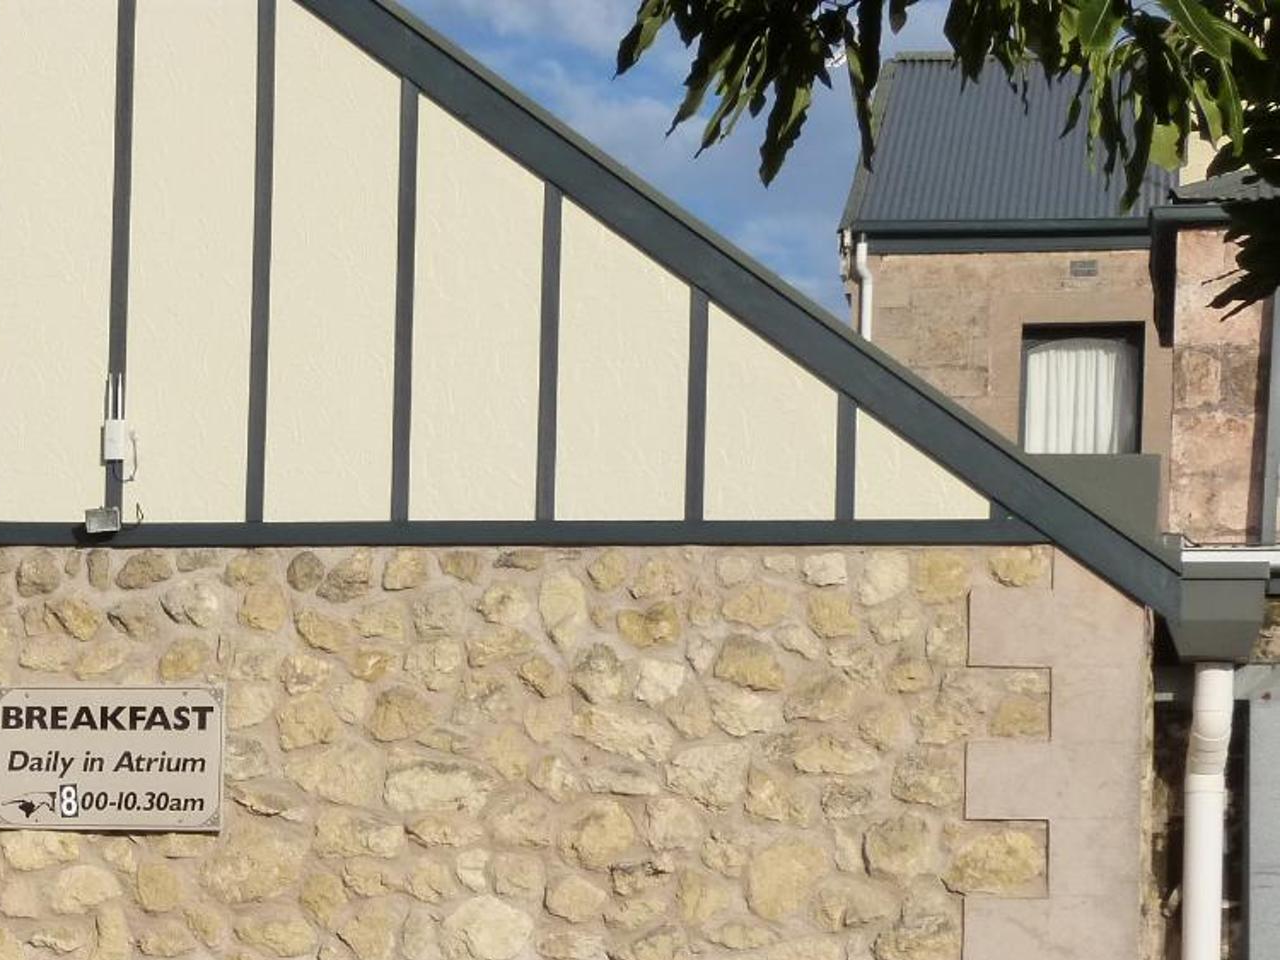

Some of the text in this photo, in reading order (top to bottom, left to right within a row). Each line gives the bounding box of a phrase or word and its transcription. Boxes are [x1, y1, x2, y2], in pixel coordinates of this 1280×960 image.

[1, 706, 214, 731] BREAKFAST
[8, 750, 206, 779] Daily in Atrium
